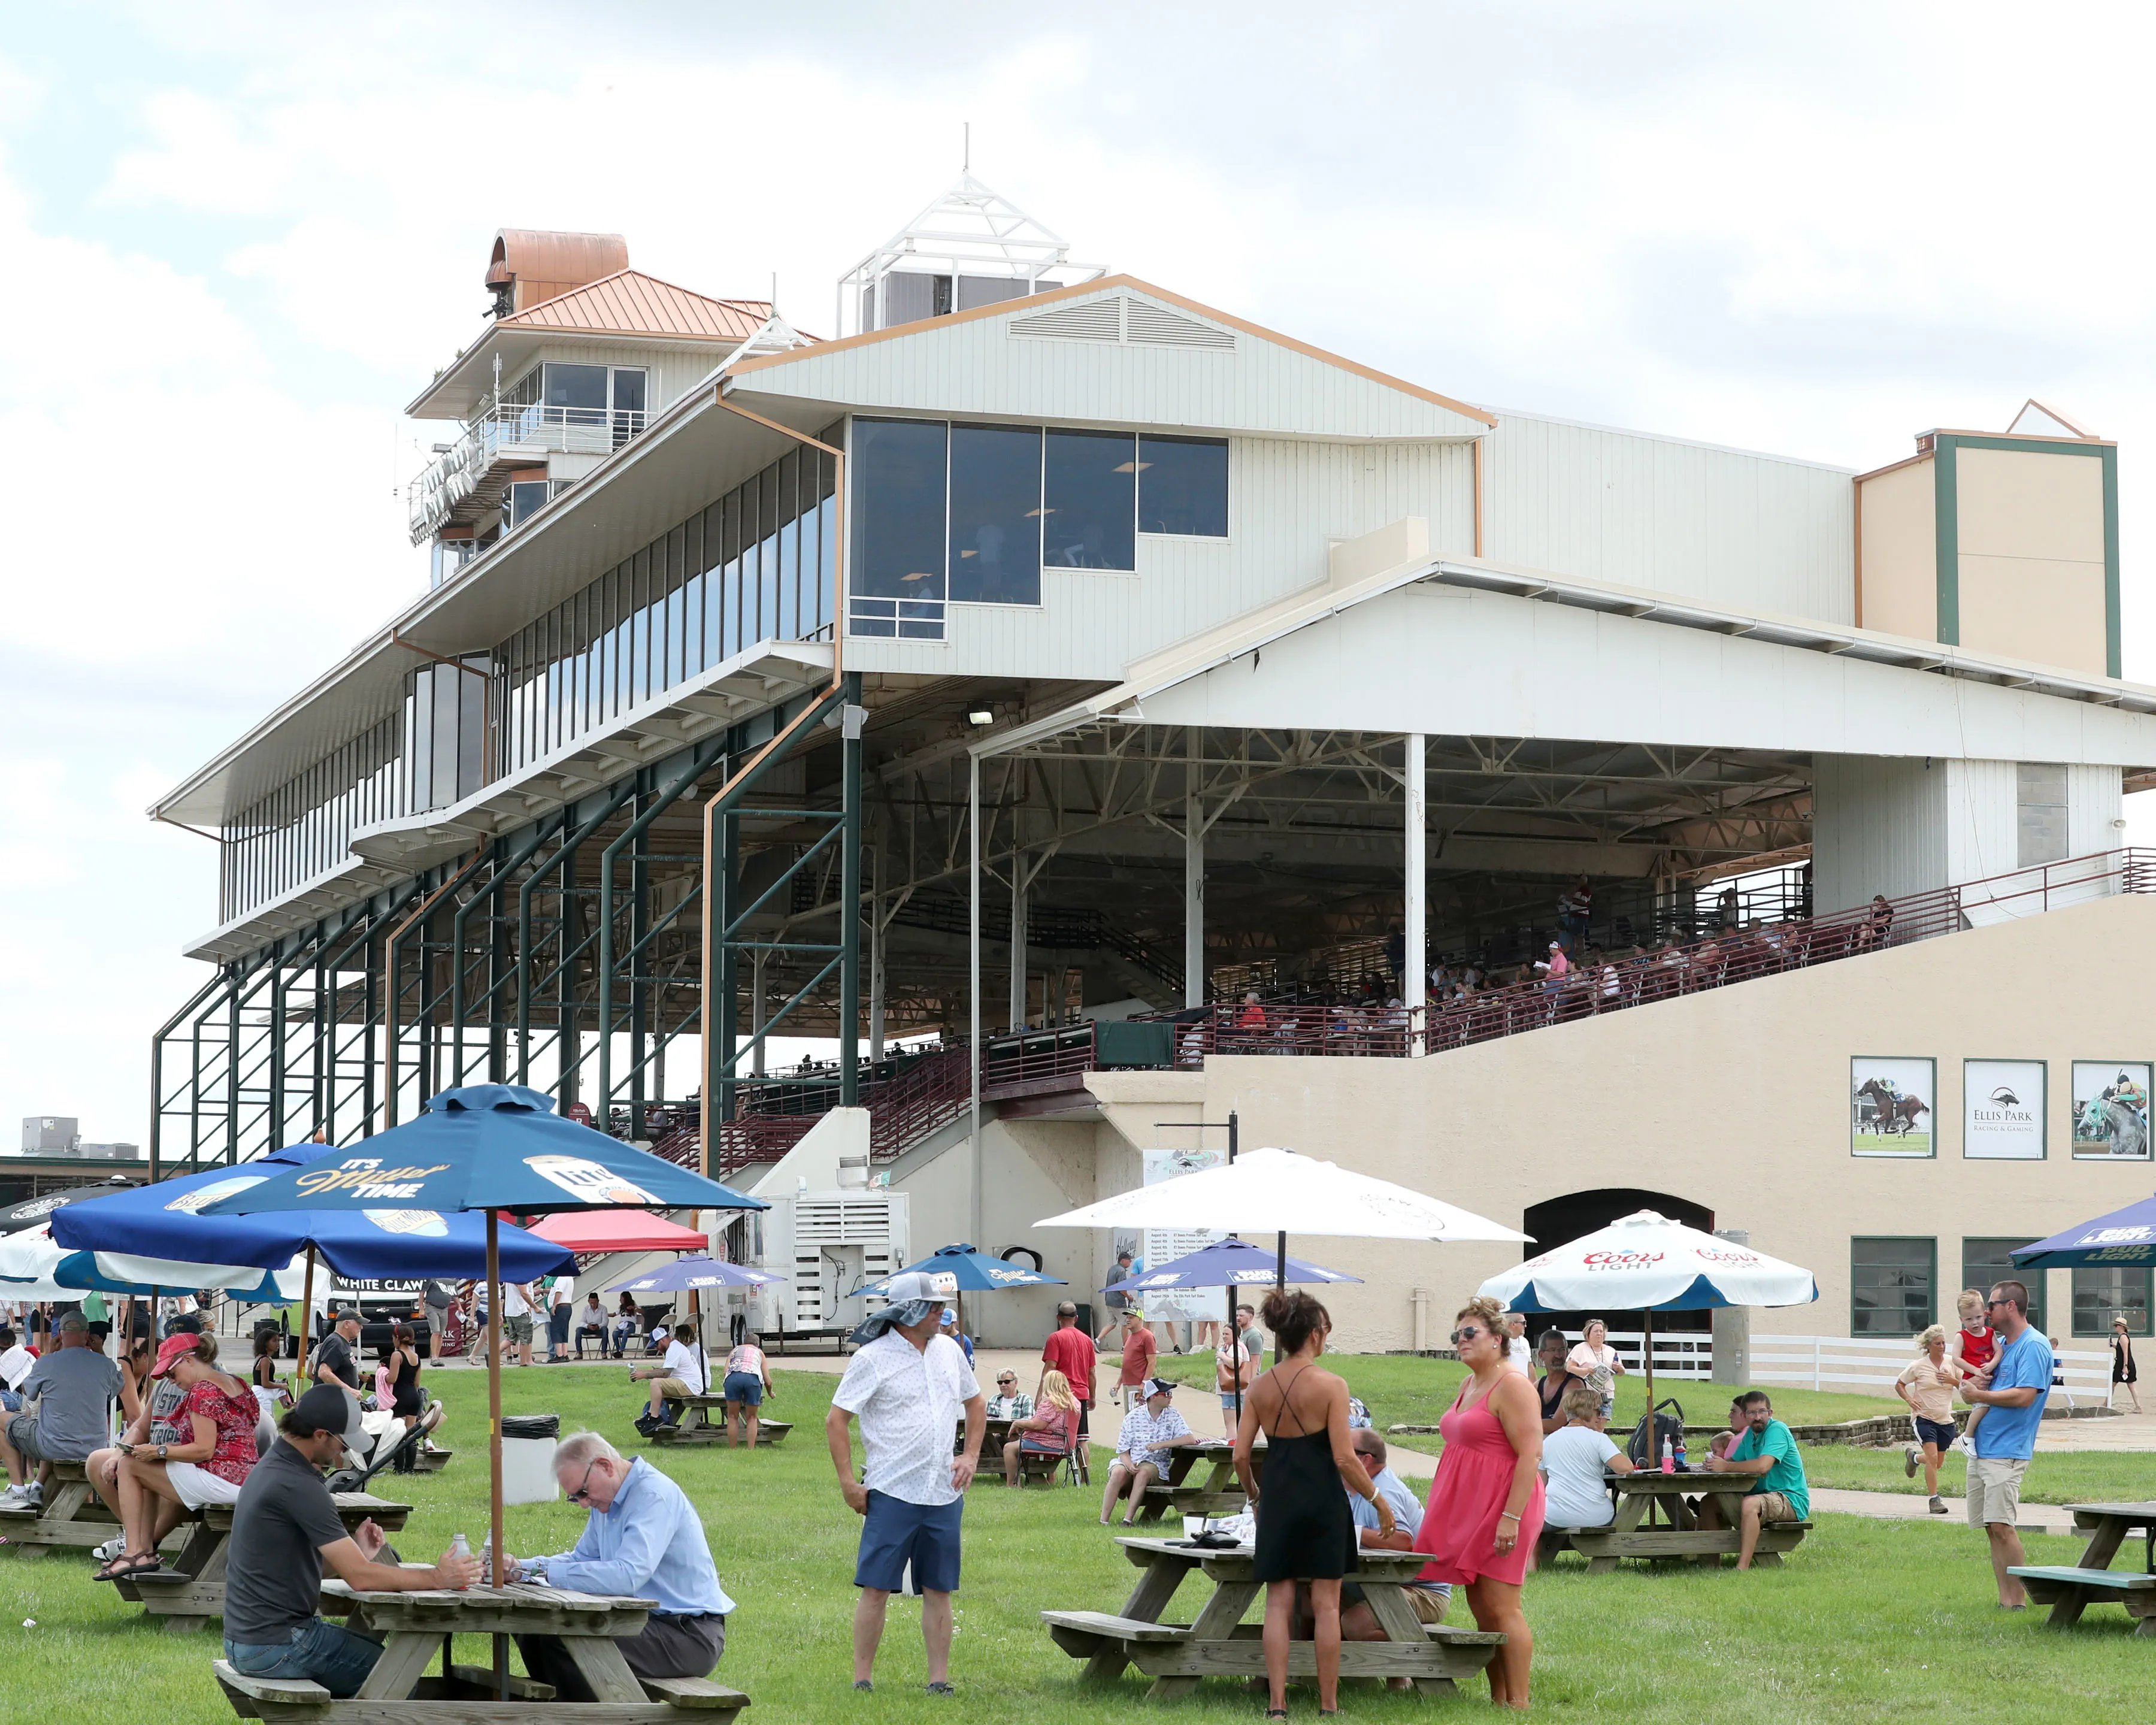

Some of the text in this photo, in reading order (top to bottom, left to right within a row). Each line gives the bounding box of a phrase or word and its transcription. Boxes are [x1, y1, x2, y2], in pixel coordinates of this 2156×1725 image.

[1974, 1110, 2032, 1121] ELLIS PARK
[339, 1158, 383, 1169] IT'S
[296, 1164, 451, 1197] Miller
[552, 1168, 614, 1187] Lite
[2080, 1231, 2153, 1243] LIGHT
[2098, 1227, 2151, 1236] BUD
[1691, 1248, 1759, 1261] Coors
[2101, 1245, 2151, 1253] BUD
[1583, 1251, 1665, 1264] Coors
[1588, 1262, 1654, 1271] LIGHT
[337, 1276, 379, 1290] WHITE
[384, 1279, 423, 1291] CLAW
[158, 1393, 182, 1412] STA
